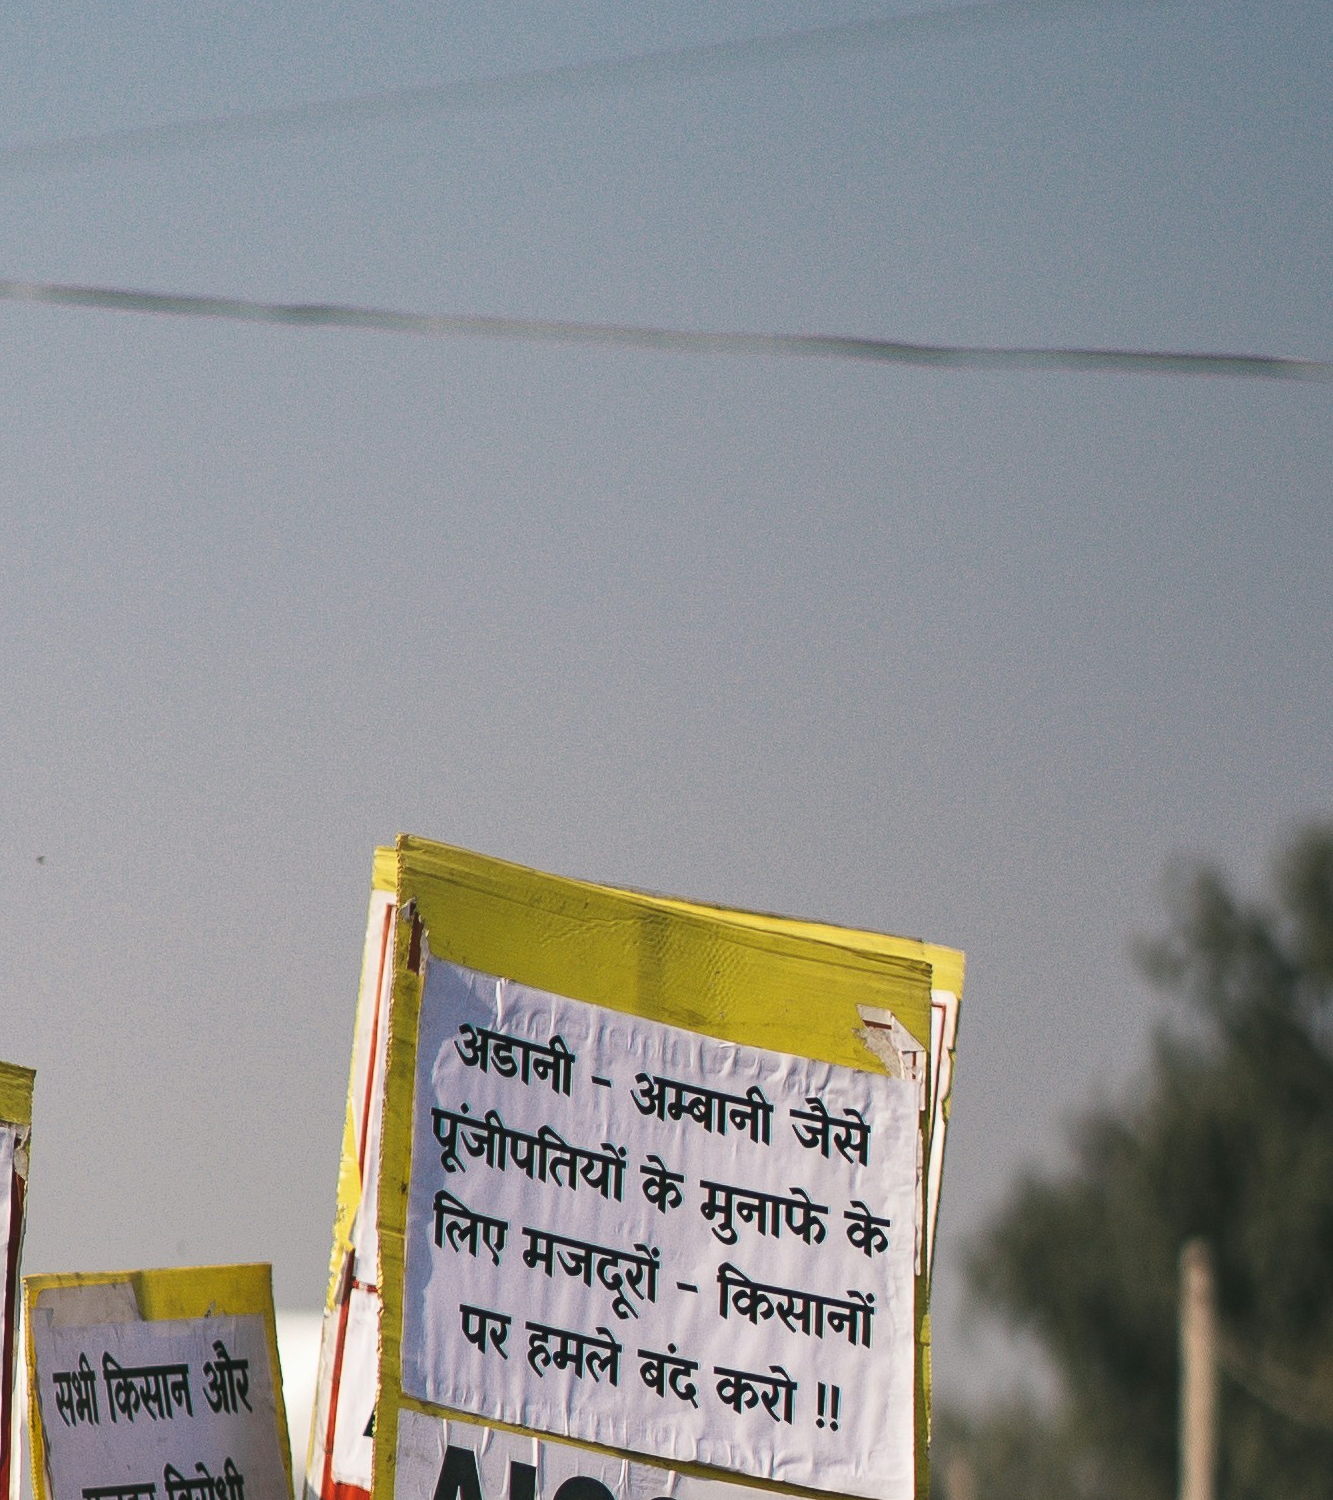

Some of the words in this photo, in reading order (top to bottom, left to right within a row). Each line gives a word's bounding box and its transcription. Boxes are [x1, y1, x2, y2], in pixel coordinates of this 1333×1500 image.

[454, 1023, 575, 1096] अडानी
[630, 1072, 773, 1146] अम्बानी
[790, 1096, 870, 1166] जैसे
[432, 1103, 626, 1201] पूंजीपतियों
[640, 1154, 684, 1214] के
[700, 1180, 828, 1246] मुनाफे
[843, 1200, 890, 1257] के
[434, 1190, 508, 1265] लिए
[522, 1227, 660, 1319] मजदूरों
[717, 1262, 875, 1348] किसानों
[53, 1351, 99, 1427] सभी
[102, 1351, 192, 1425] किसान
[202, 1339, 253, 1418] और
[460, 1303, 510, 1359] पर
[525, 1321, 622, 1387] हमले
[638, 1343, 698, 1408] बंद
[714, 1365, 797, 1425] करो
[816, 1382, 841, 1432] !!
